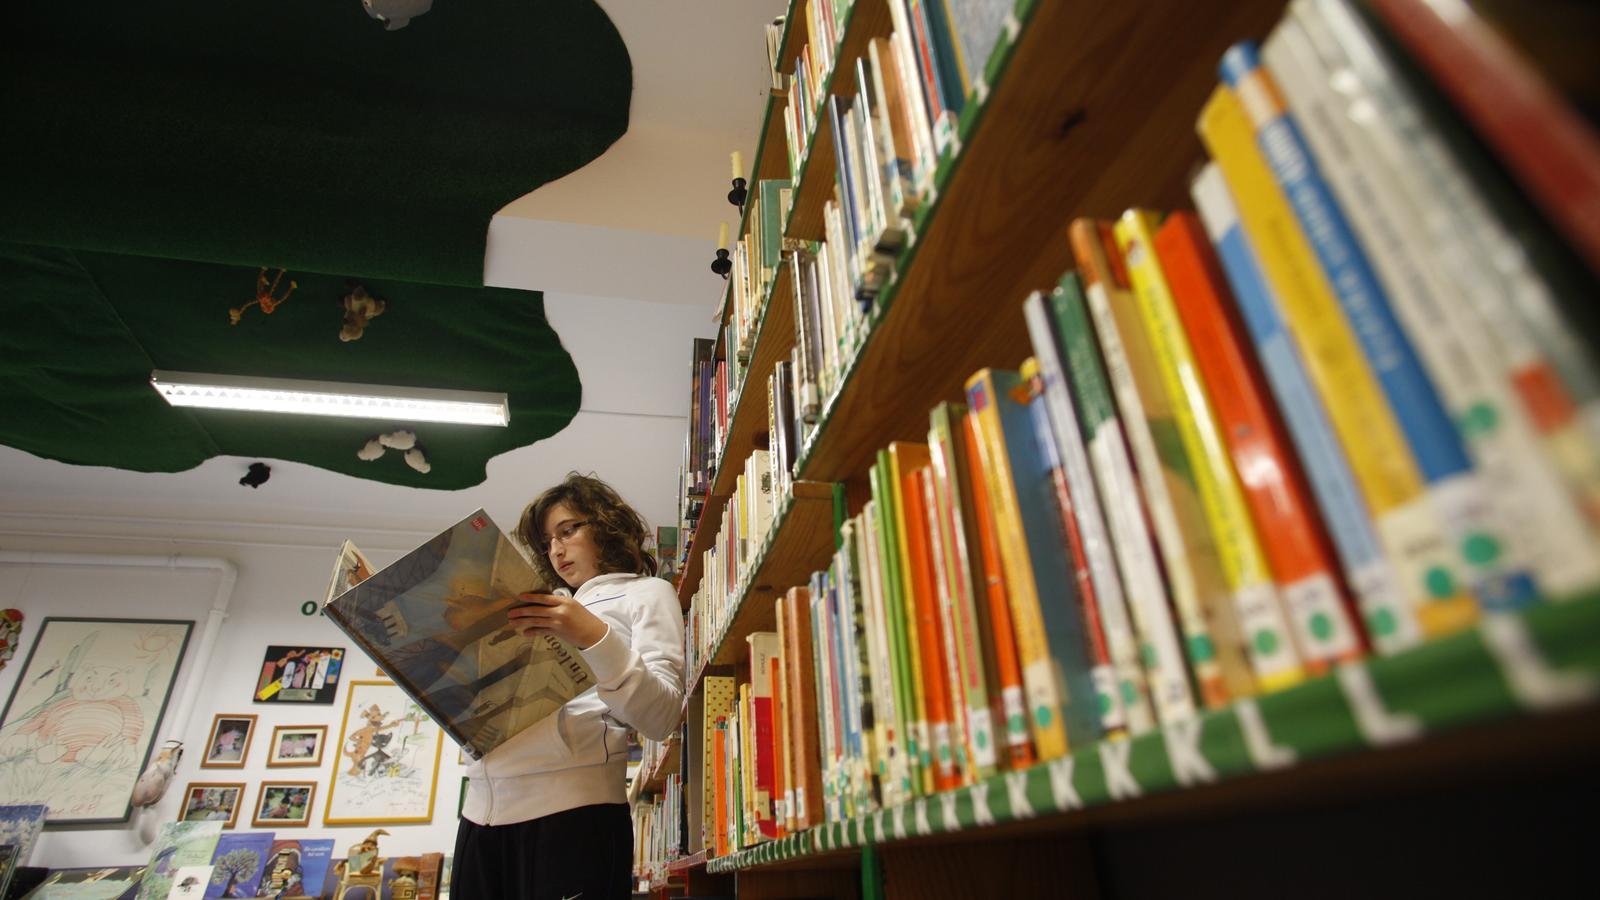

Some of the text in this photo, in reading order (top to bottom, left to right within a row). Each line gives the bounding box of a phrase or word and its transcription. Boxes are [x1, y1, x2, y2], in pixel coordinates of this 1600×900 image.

[543, 634, 572, 666] león
[570, 662, 588, 684] Un
[1005, 772, 1035, 818] K
[1049, 754, 1083, 811] K
[1100, 739, 1142, 799] K
[1163, 714, 1218, 787] K
[1233, 698, 1295, 768] L
[1337, 663, 1422, 744] L
[1482, 614, 1599, 706] L
